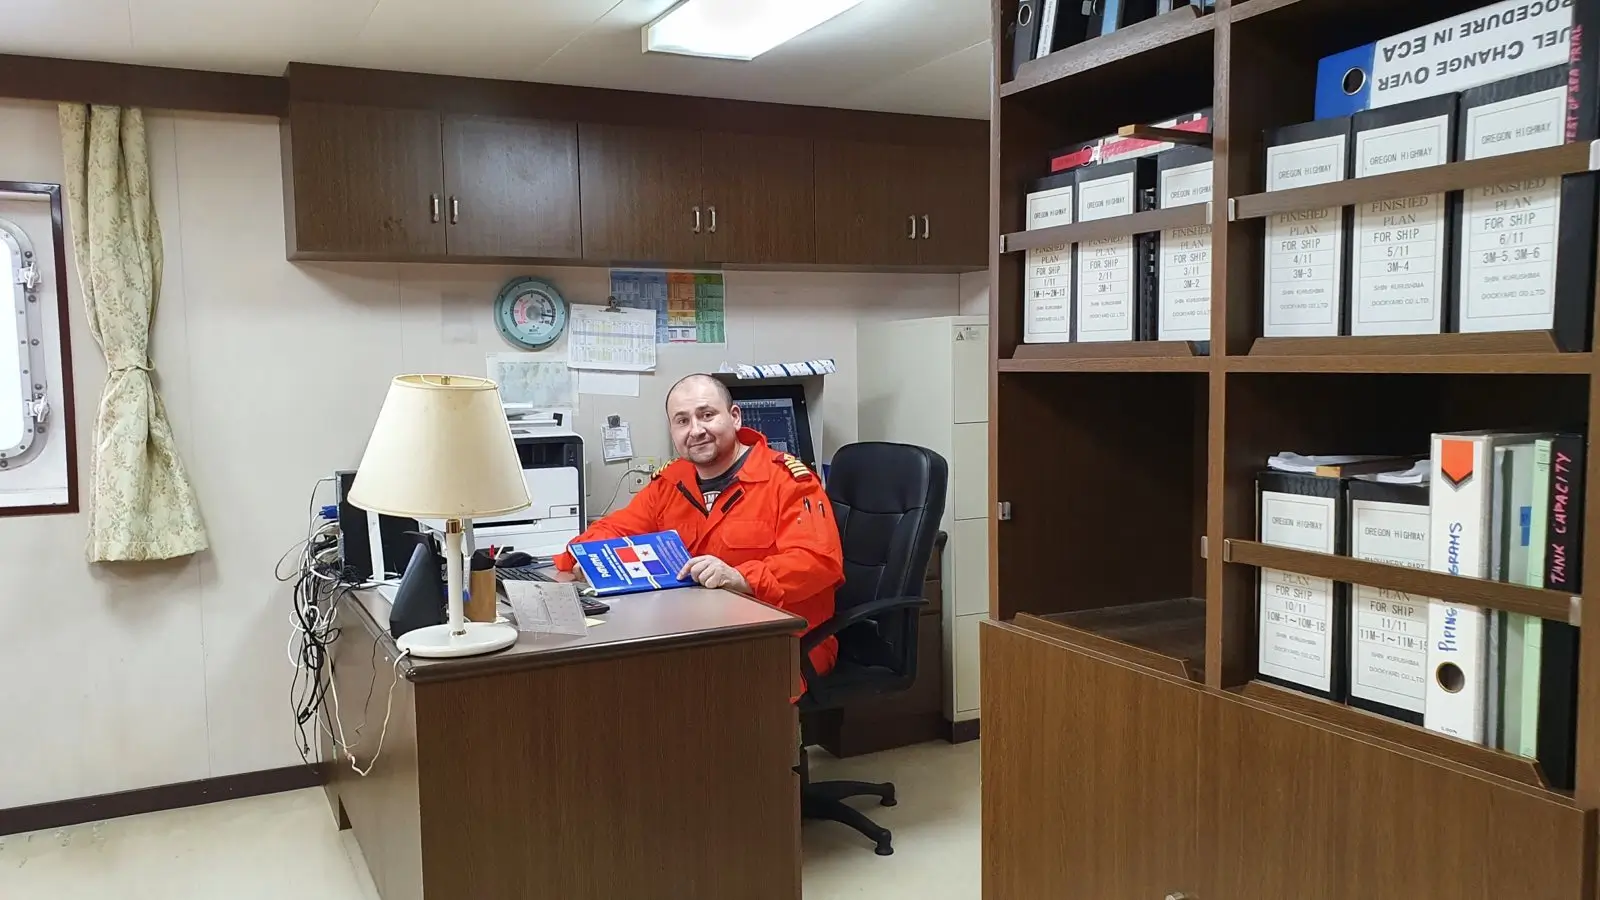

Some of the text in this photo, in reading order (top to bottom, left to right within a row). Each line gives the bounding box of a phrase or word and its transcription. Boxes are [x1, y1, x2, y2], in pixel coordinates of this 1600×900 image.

[1382, 0, 1575, 62] ROCEDURE IN ECA
[1378, 26, 1572, 91] UEL CHANGE OVER
[1482, 122, 1552, 144] OREGON HIGHWAY
[1370, 147, 1432, 166] OREGON HIGHWAY
[1278, 164, 1332, 179] OREGON HIGHWAY
[1170, 185, 1212, 199] OREGON HIGHWA
[1483, 177, 1546, 196] FINISHED
[1087, 197, 1125, 209] OREGON HIGHWAY
[1372, 196, 1428, 212] FINISHED
[1496, 196, 1532, 211] PLAN
[1034, 208, 1067, 219] OREGON HIGHWAY
[1280, 209, 1328, 223] FINISHED
[1384, 214, 1416, 226] PLAN
[1484, 212, 1536, 230] FOR SHIP
[1290, 225, 1318, 236] PLAN
[1374, 228, 1420, 243] FOR SHIP
[1180, 240, 1204, 250] PLAN
[1282, 238, 1320, 251] FOR SHIP
[1500, 232, 1524, 245] 6/11
[1096, 247, 1116, 256] PLAN
[1174, 252, 1206, 263] FOR SHIP
[1388, 246, 1409, 257] 5/11
[1041, 256, 1059, 264] PLAN
[1090, 259, 1118, 270] FOR SHIP
[1293, 254, 1312, 264] 4/11
[1036, 266, 1060, 276] FOR SHIP
[1184, 266, 1199, 276] 3/11
[1293, 268, 1312, 278] 3M-3
[1387, 261, 1409, 272] 3M-4
[1044, 278, 1056, 286] 1/11
[1098, 272, 1112, 281] 2/11
[1098, 284, 1112, 292] 3M-1
[1183, 279, 1200, 288] 3M-2
[1272, 516, 1322, 530] OREGON HIGHWAY
[1550, 452, 1572, 584] TANK CAPACITY
[1365, 527, 1425, 540] OREGON HIGHWAY
[1283, 573, 1309, 586] PLAN
[1276, 585, 1312, 600] FOR SHIP
[1438, 522, 1462, 652] PIPING GRAMS
[1286, 601, 1306, 613] 10/11
[1370, 601, 1414, 616] FOR SHIP
[1382, 618, 1407, 631] 11/11
